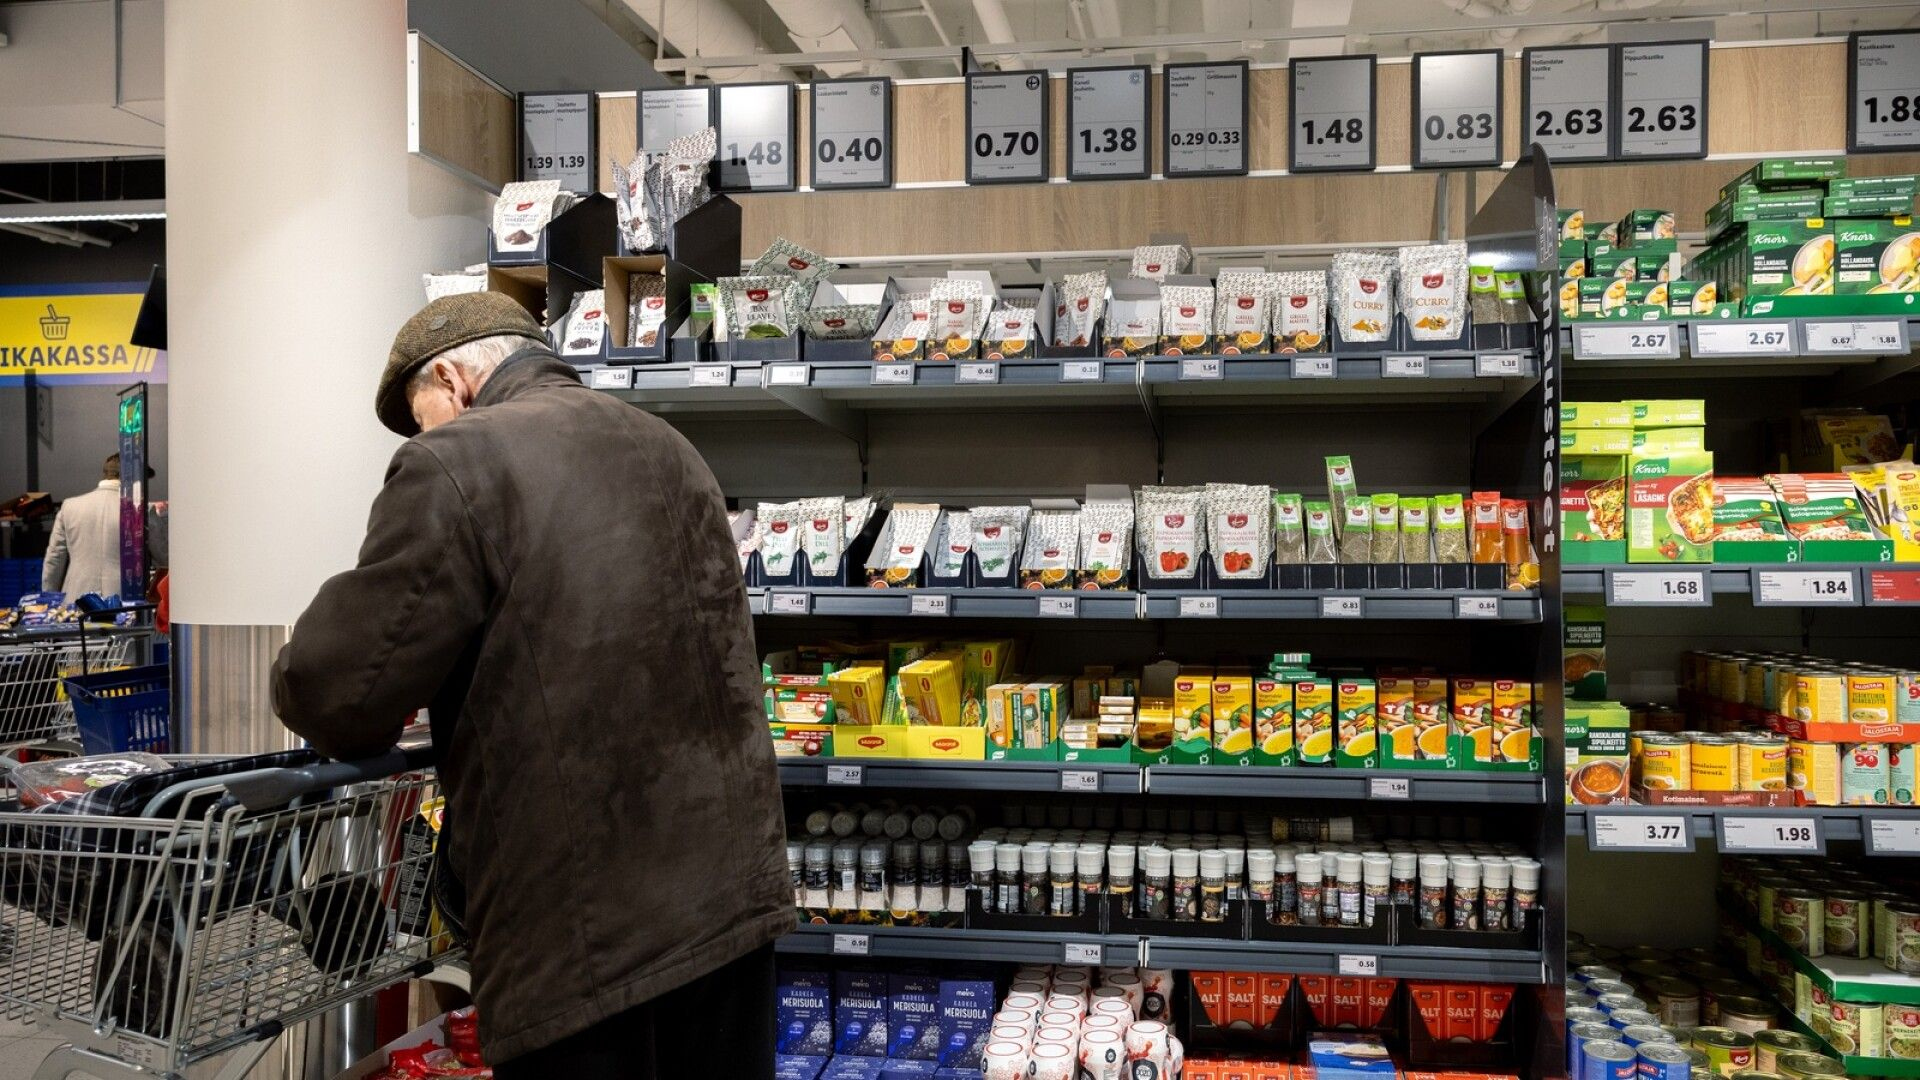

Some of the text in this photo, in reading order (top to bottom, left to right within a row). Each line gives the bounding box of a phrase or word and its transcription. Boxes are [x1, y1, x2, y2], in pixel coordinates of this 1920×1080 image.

[1535, 108, 1603, 136] 2.63
[1627, 104, 1697, 133] 2.63
[1302, 118, 1364, 146] 1.48
[1424, 112, 1493, 141] 0.83
[974, 130, 1040, 158] 0.70
[1079, 126, 1138, 154] 1.38
[1171, 132, 1204, 146] 0.29
[1208, 131, 1240, 145] 0.33
[726, 141, 783, 166] 1.48
[818, 136, 883, 164] 0.40
[527, 156, 553, 169] 1.39
[558, 155, 585, 168] 1.39
[1754, 233, 1788, 244] Knorr
[1840, 231, 1876, 242] Knorr
[1353, 300, 1383, 311] CURRY
[1415, 298, 1449, 307] CURRY
[1631, 334, 1666, 348] 2.67
[1749, 332, 1785, 345] 2.67
[0, 344, 128, 367] IKAKASSA
[1541, 274, 1554, 553] mausteet
[1634, 464, 1667, 474] Knorr
[1561, 498, 1586, 506] GNETTE
[1634, 494, 1666, 502] LASAGNE
[1664, 581, 1698, 594] 1.68
[1812, 581, 1847, 594] 1.84
[1565, 724, 1586, 734] norr
[1864, 726, 1900, 735] JALOSTAJA
[1855, 755, 1879, 768] 90
[1647, 826, 1680, 839] 3.77
[1776, 827, 1810, 841] 1.98
[902, 994, 925, 1002] KARKEA
[956, 988, 975, 997] meira
[1200, 994, 1221, 1003] ALT
[1228, 992, 1256, 1002] SALT
[782, 997, 824, 1008] MERISUOLA
[840, 997, 882, 1009] MERISUOLA
[953, 1000, 977, 1008] KARKEA
[1262, 994, 1285, 1004] SAL
[1307, 994, 1326, 1004] ALT
[1334, 995, 1362, 1004] SALT
[1369, 996, 1390, 1006] SAL
[893, 1001, 935, 1013] MERISUOLA
[1420, 1007, 1440, 1017] ALT
[1447, 1007, 1476, 1017] SALT
[1483, 1008, 1504, 1018] SAL
[944, 1007, 987, 1020] MERISUOLA
